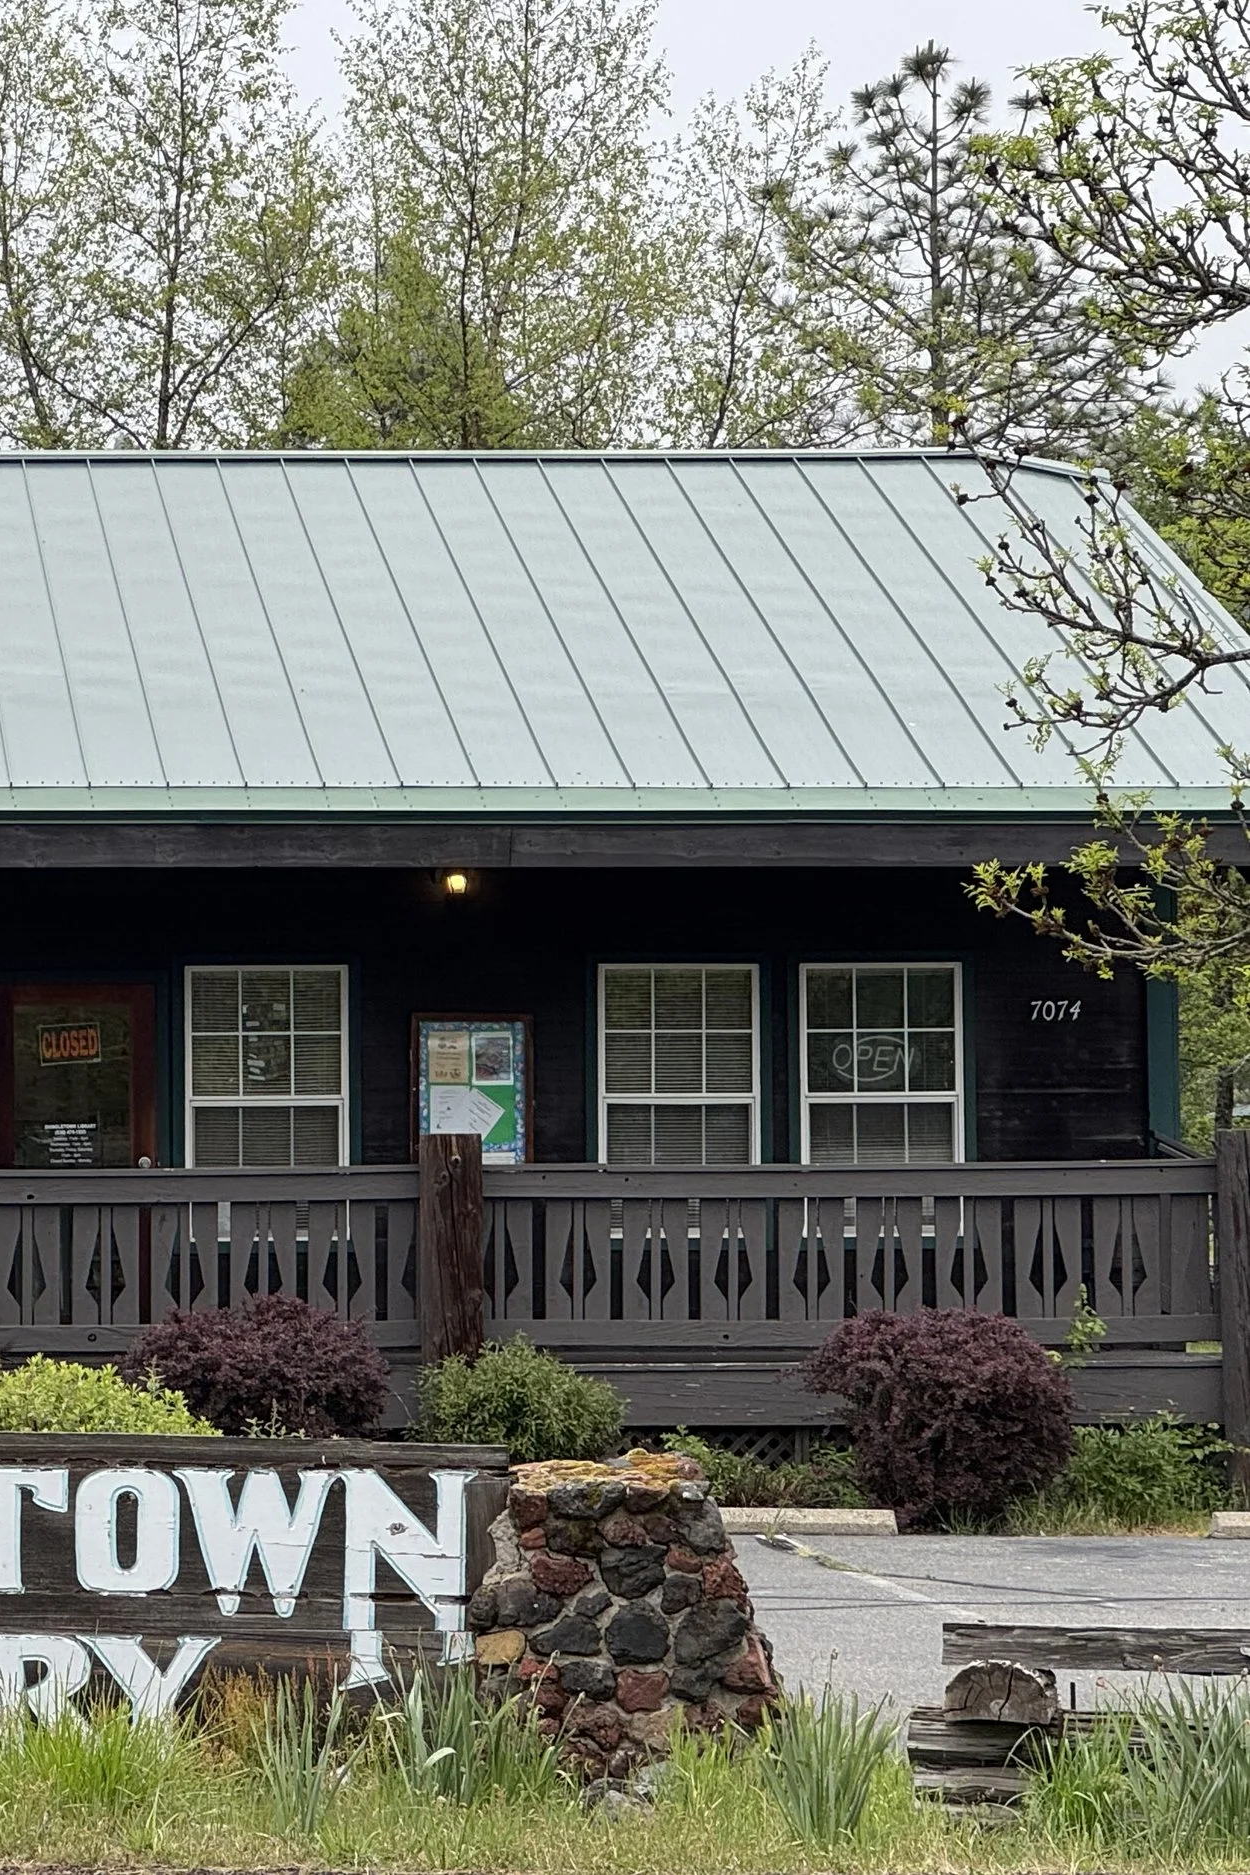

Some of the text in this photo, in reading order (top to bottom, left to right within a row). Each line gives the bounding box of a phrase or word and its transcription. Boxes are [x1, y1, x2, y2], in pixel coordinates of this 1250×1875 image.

[1030, 1000, 1082, 1021] 7074
[42, 1028, 98, 1058] CLOSED
[832, 1044, 915, 1072] OPEN
